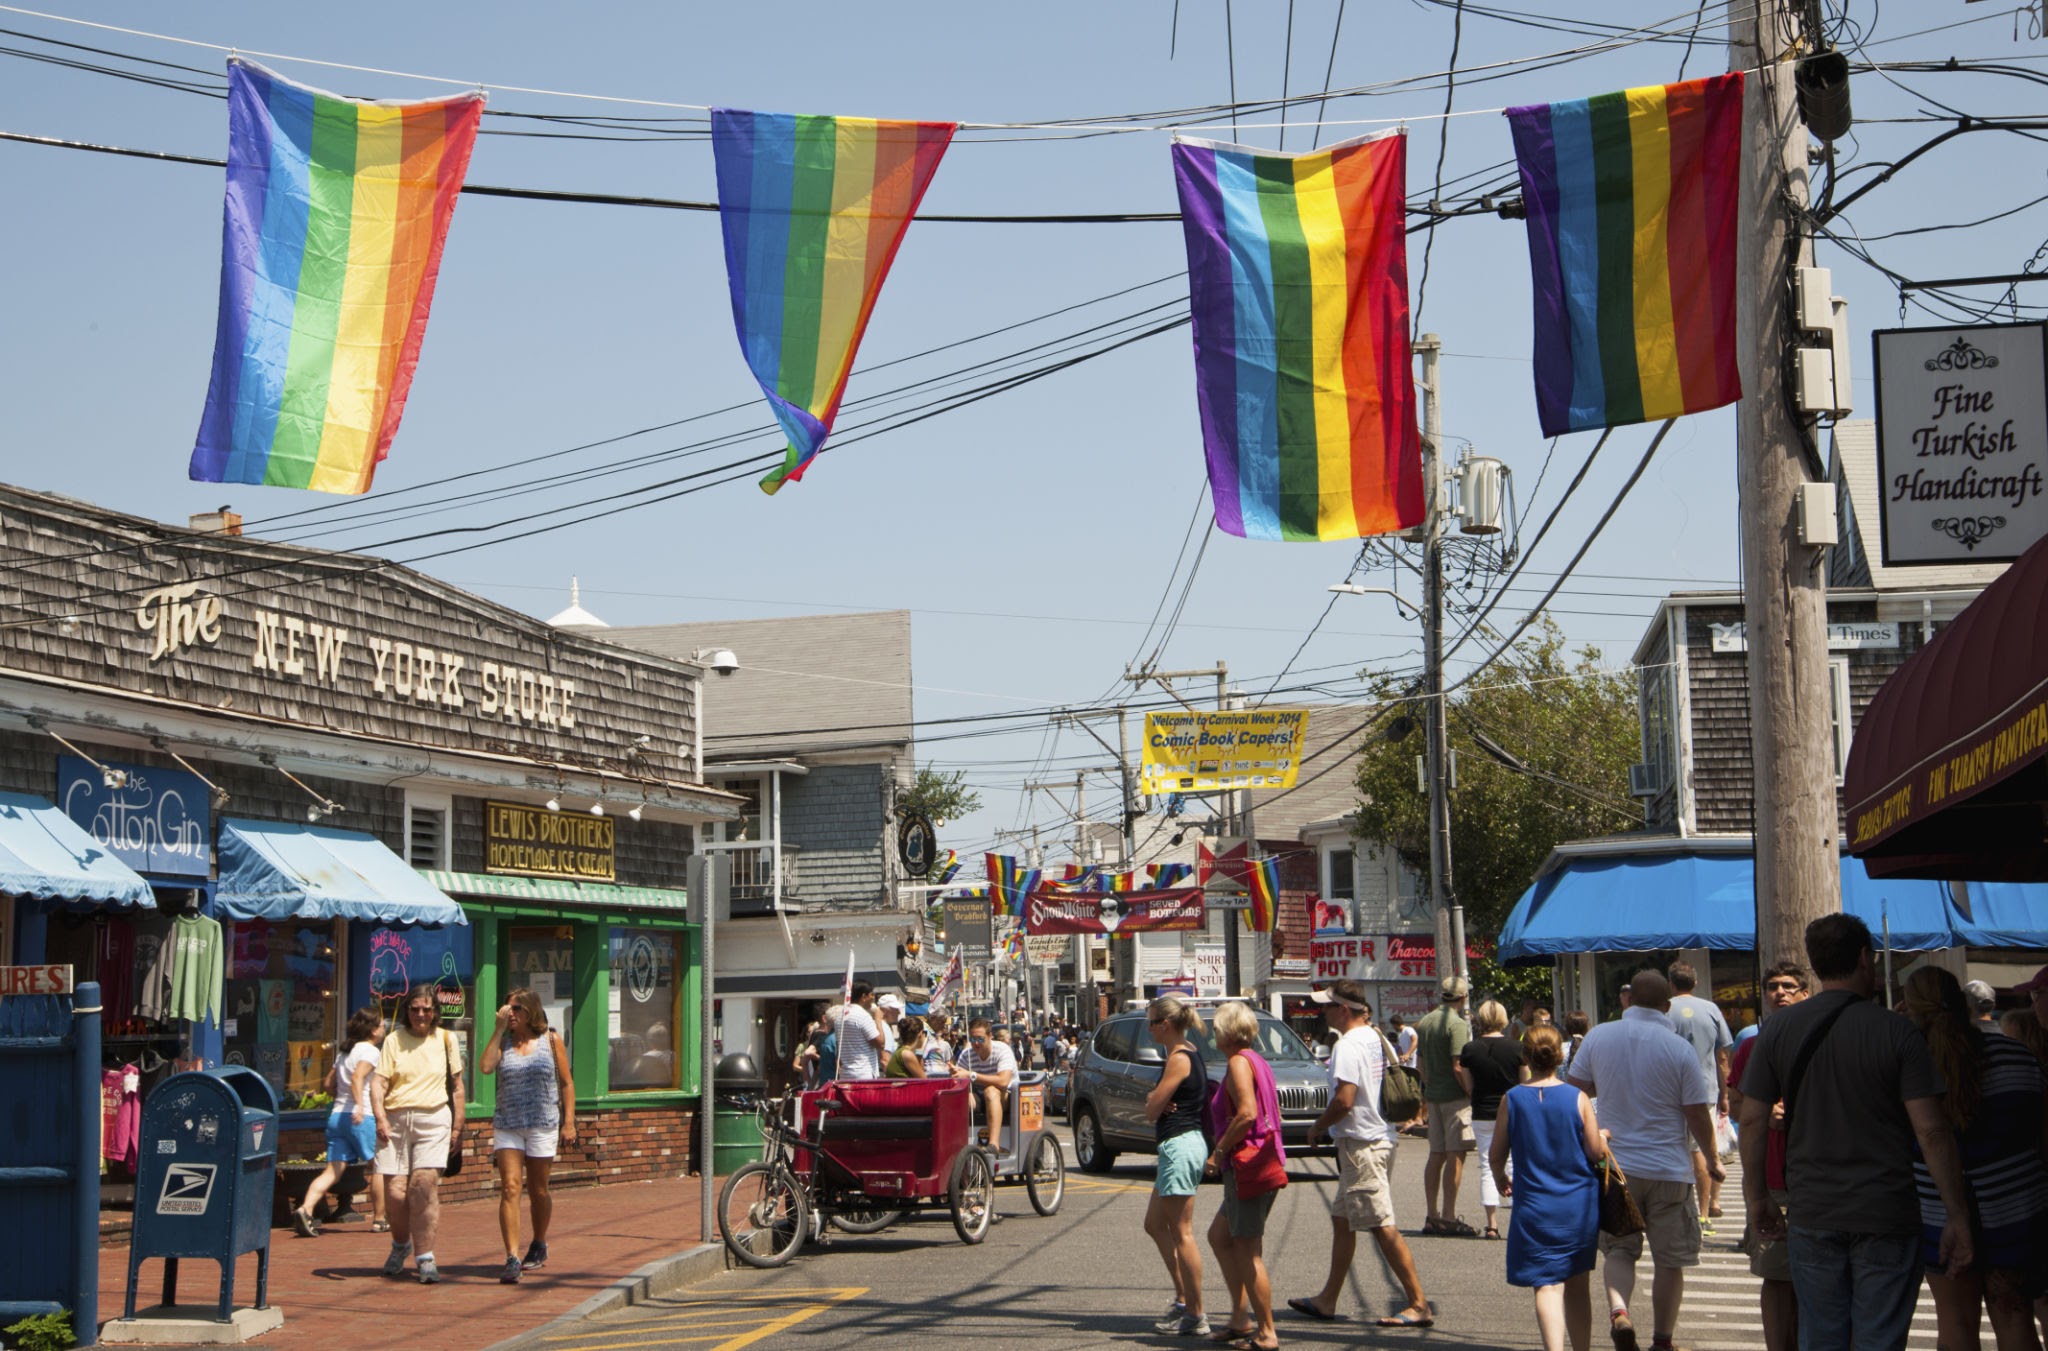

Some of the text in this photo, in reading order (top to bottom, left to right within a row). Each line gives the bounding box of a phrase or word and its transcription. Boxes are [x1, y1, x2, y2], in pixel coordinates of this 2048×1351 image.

[1931, 383, 1995, 420] Fine
[1912, 419, 2017, 461] Turkish
[1892, 463, 2043, 508] Handicraft
[1837, 625, 1892, 642] Times
[136, 579, 575, 728] The NEW YORK STORE
[1152, 713, 1302, 727] Welcome to Carnival Week 2014
[1151, 730, 1294, 748] Comic Book Capers!
[157, 789, 204, 860] Gin
[489, 807, 612, 850] LEWIS BROTHERS
[557, 850, 575, 873] ICE
[577, 851, 613, 876] CREAM
[947, 903, 984, 911] Governor
[954, 911, 988, 921] Bradford
[1387, 938, 1436, 960] Charcoa
[1318, 960, 1351, 976] POT
[1400, 961, 1437, 977] STE
[1200, 976, 1225, 985] STUF
